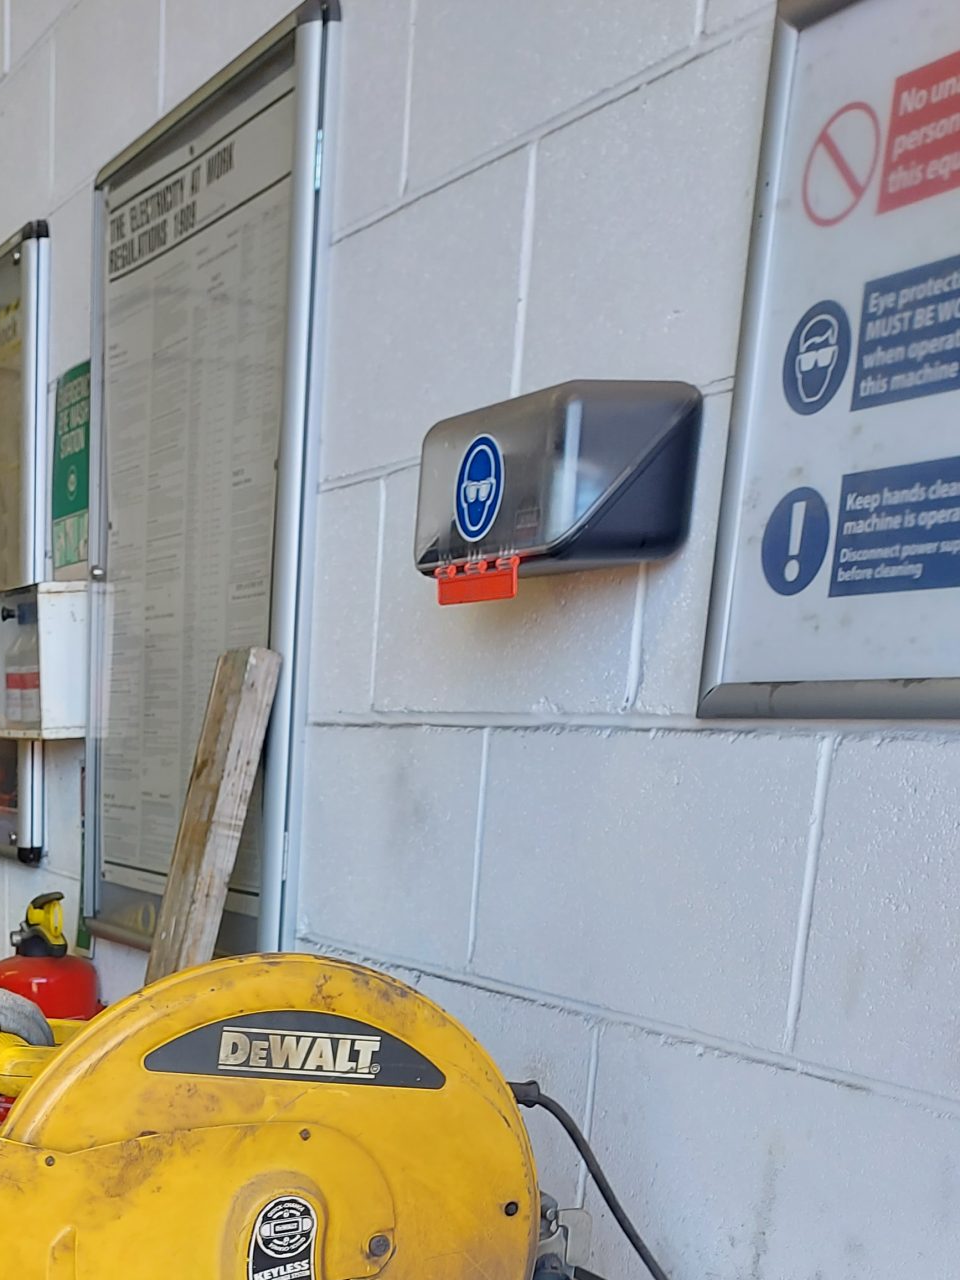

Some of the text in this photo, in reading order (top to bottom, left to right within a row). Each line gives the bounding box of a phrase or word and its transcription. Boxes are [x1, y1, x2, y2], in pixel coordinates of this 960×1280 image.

[898, 87, 928, 117] No
[109, 141, 235, 246] THE ELECTRICITY AT WORK
[109, 219, 167, 275] REGULATIONS
[868, 292, 896, 315] Eye
[865, 310, 912, 342] MUST
[913, 305, 936, 330] BE
[862, 345, 905, 369] when
[859, 361, 959, 397] this machine
[846, 492, 880, 513] Keep
[881, 482, 927, 507] hands
[843, 511, 902, 535] machine
[903, 509, 917, 529] is
[840, 543, 900, 563] Disconnect
[900, 541, 939, 561] power
[837, 560, 924, 582] before cleaning
